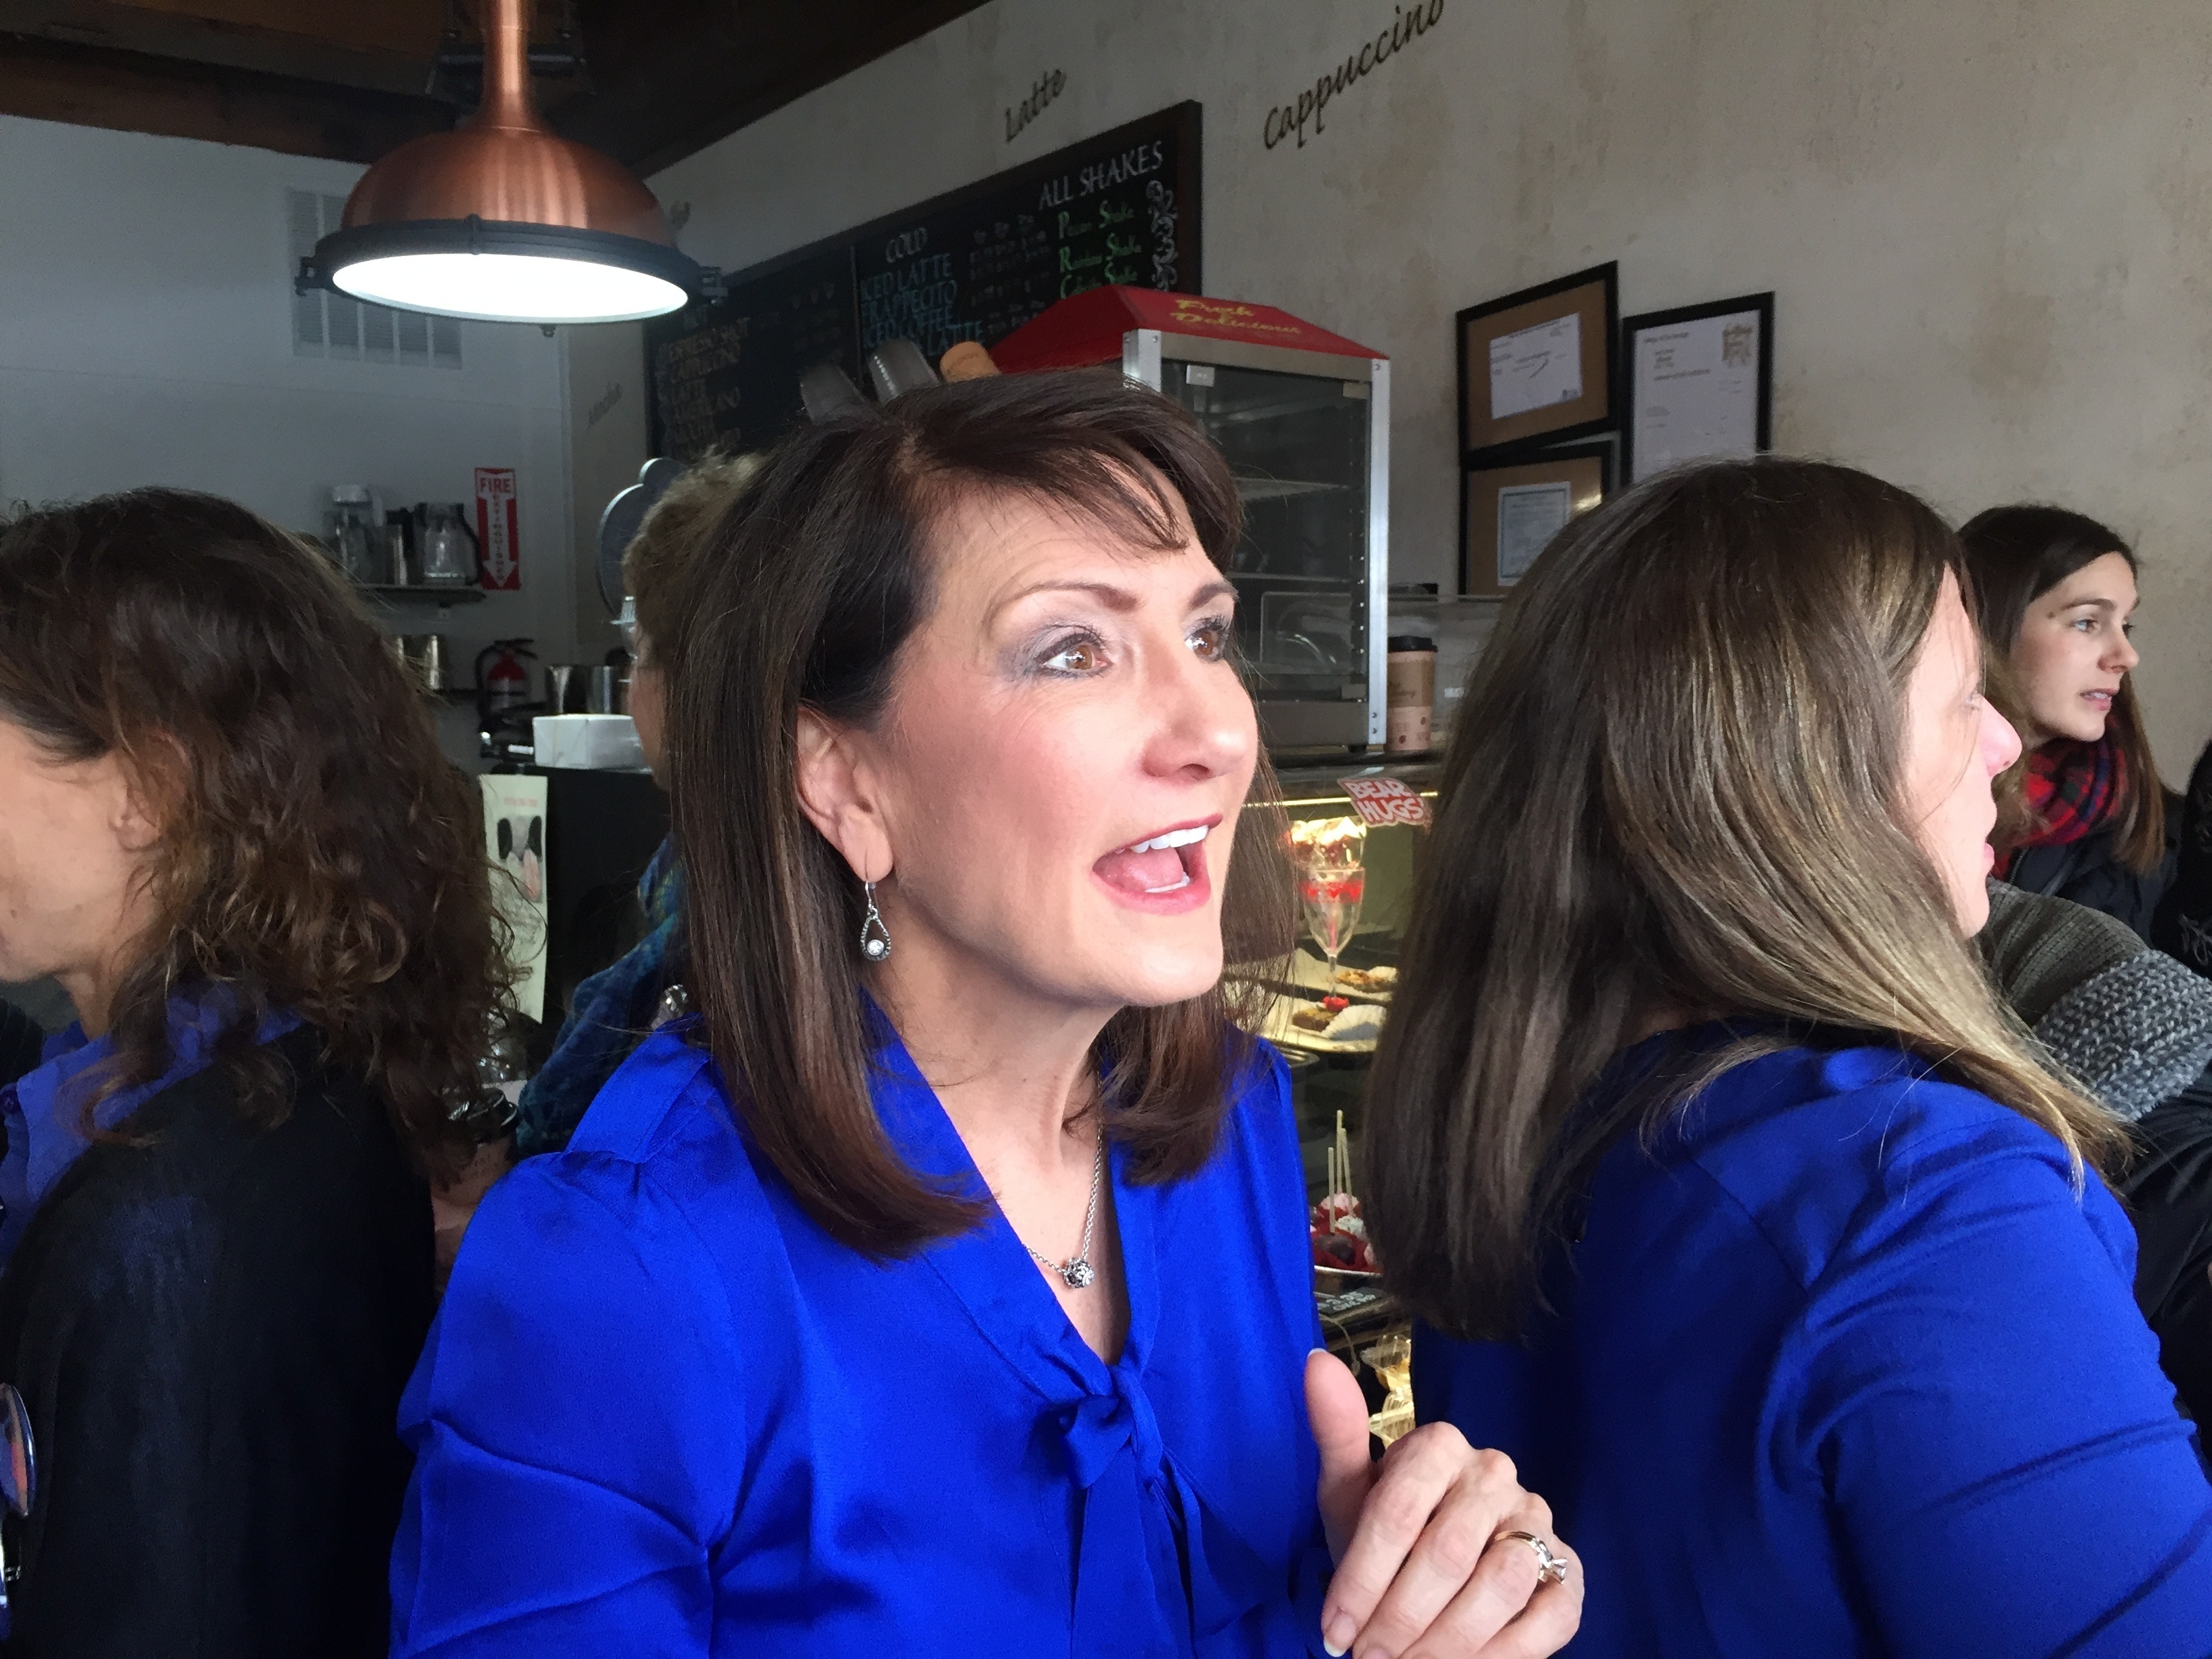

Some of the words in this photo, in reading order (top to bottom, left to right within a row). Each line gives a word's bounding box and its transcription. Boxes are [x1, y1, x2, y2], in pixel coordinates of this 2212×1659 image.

[1005, 68, 1067, 144] Latte
[1038, 174, 1075, 211] ALL
[1079, 140, 1163, 197] SHAKES
[885, 226, 928, 264] COLD
[897, 252, 953, 293] LATTE
[927, 319, 985, 356] LATTE
[479, 476, 512, 493] FIRE
[1344, 779, 1412, 799] BEAR
